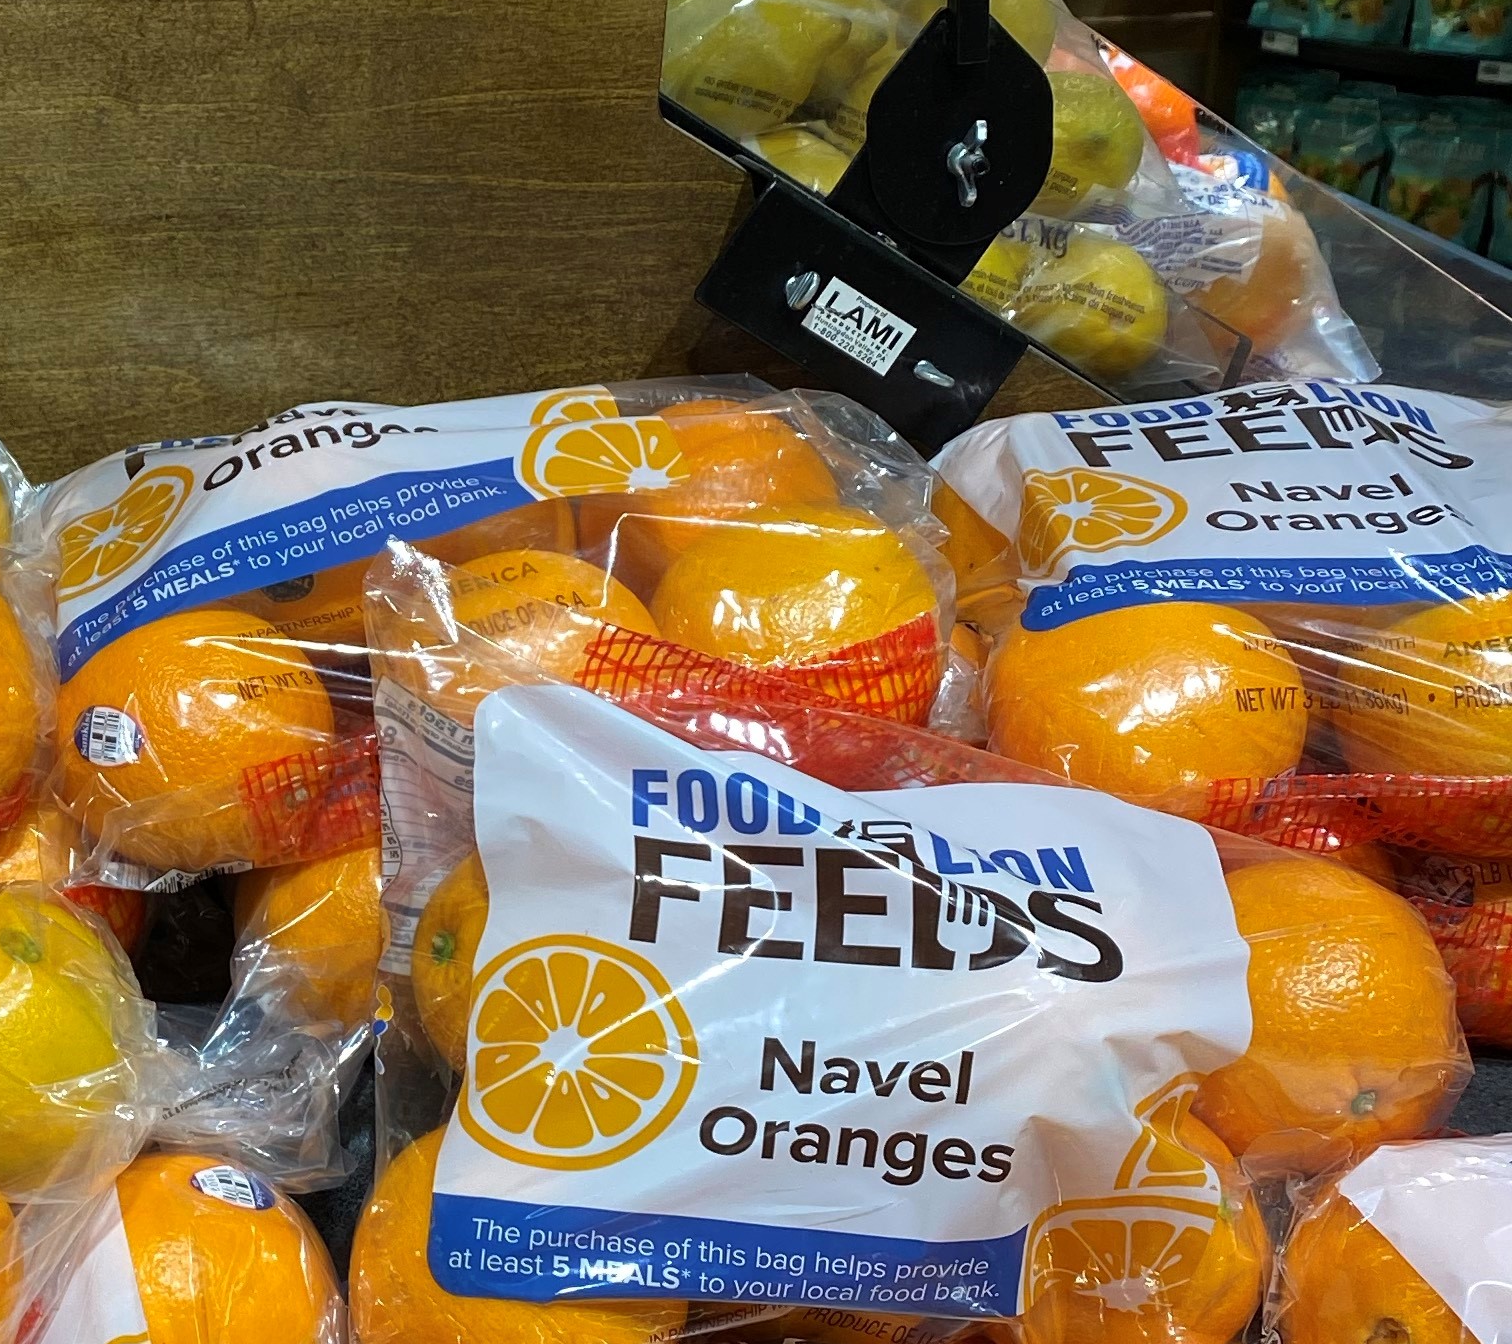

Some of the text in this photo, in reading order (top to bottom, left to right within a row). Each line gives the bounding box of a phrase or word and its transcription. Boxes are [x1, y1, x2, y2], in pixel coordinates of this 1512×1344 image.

[820, 309, 867, 341] PRODUCTS
[825, 291, 903, 350] LAMI
[856, 296, 881, 314] Property
[813, 322, 877, 367] 1-800-220-5264
[1051, 383, 1438, 433] FOOD LION
[1067, 404, 1474, 469] FEEDS
[283, 476, 480, 544] bag helps provide
[388, 484, 508, 527] food bank.
[1229, 473, 1414, 502] Navel
[1041, 599, 1064, 617] at
[1068, 582, 1126, 606] least
[1132, 580, 1146, 592] 5
[1259, 579, 1282, 592] to
[1289, 579, 1346, 596] your
[1350, 579, 1408, 593] local
[1109, 564, 1347, 588] purchase of this bag
[631, 768, 1093, 893] FOOD LION
[629, 834, 1124, 984] FEEDS
[759, 1037, 974, 1105] Navel
[699, 1106, 1014, 1186] Oranges
[448, 1248, 473, 1269] at
[479, 1251, 544, 1276] least
[551, 1256, 569, 1277] 5
[699, 1272, 725, 1293] to
[733, 1276, 793, 1299] your
[800, 1276, 861, 1301] local
[868, 1280, 926, 1302] food
[934, 1278, 1000, 1301] bank.
[472, 1218, 988, 1283] The purchase of this bag helps provide
